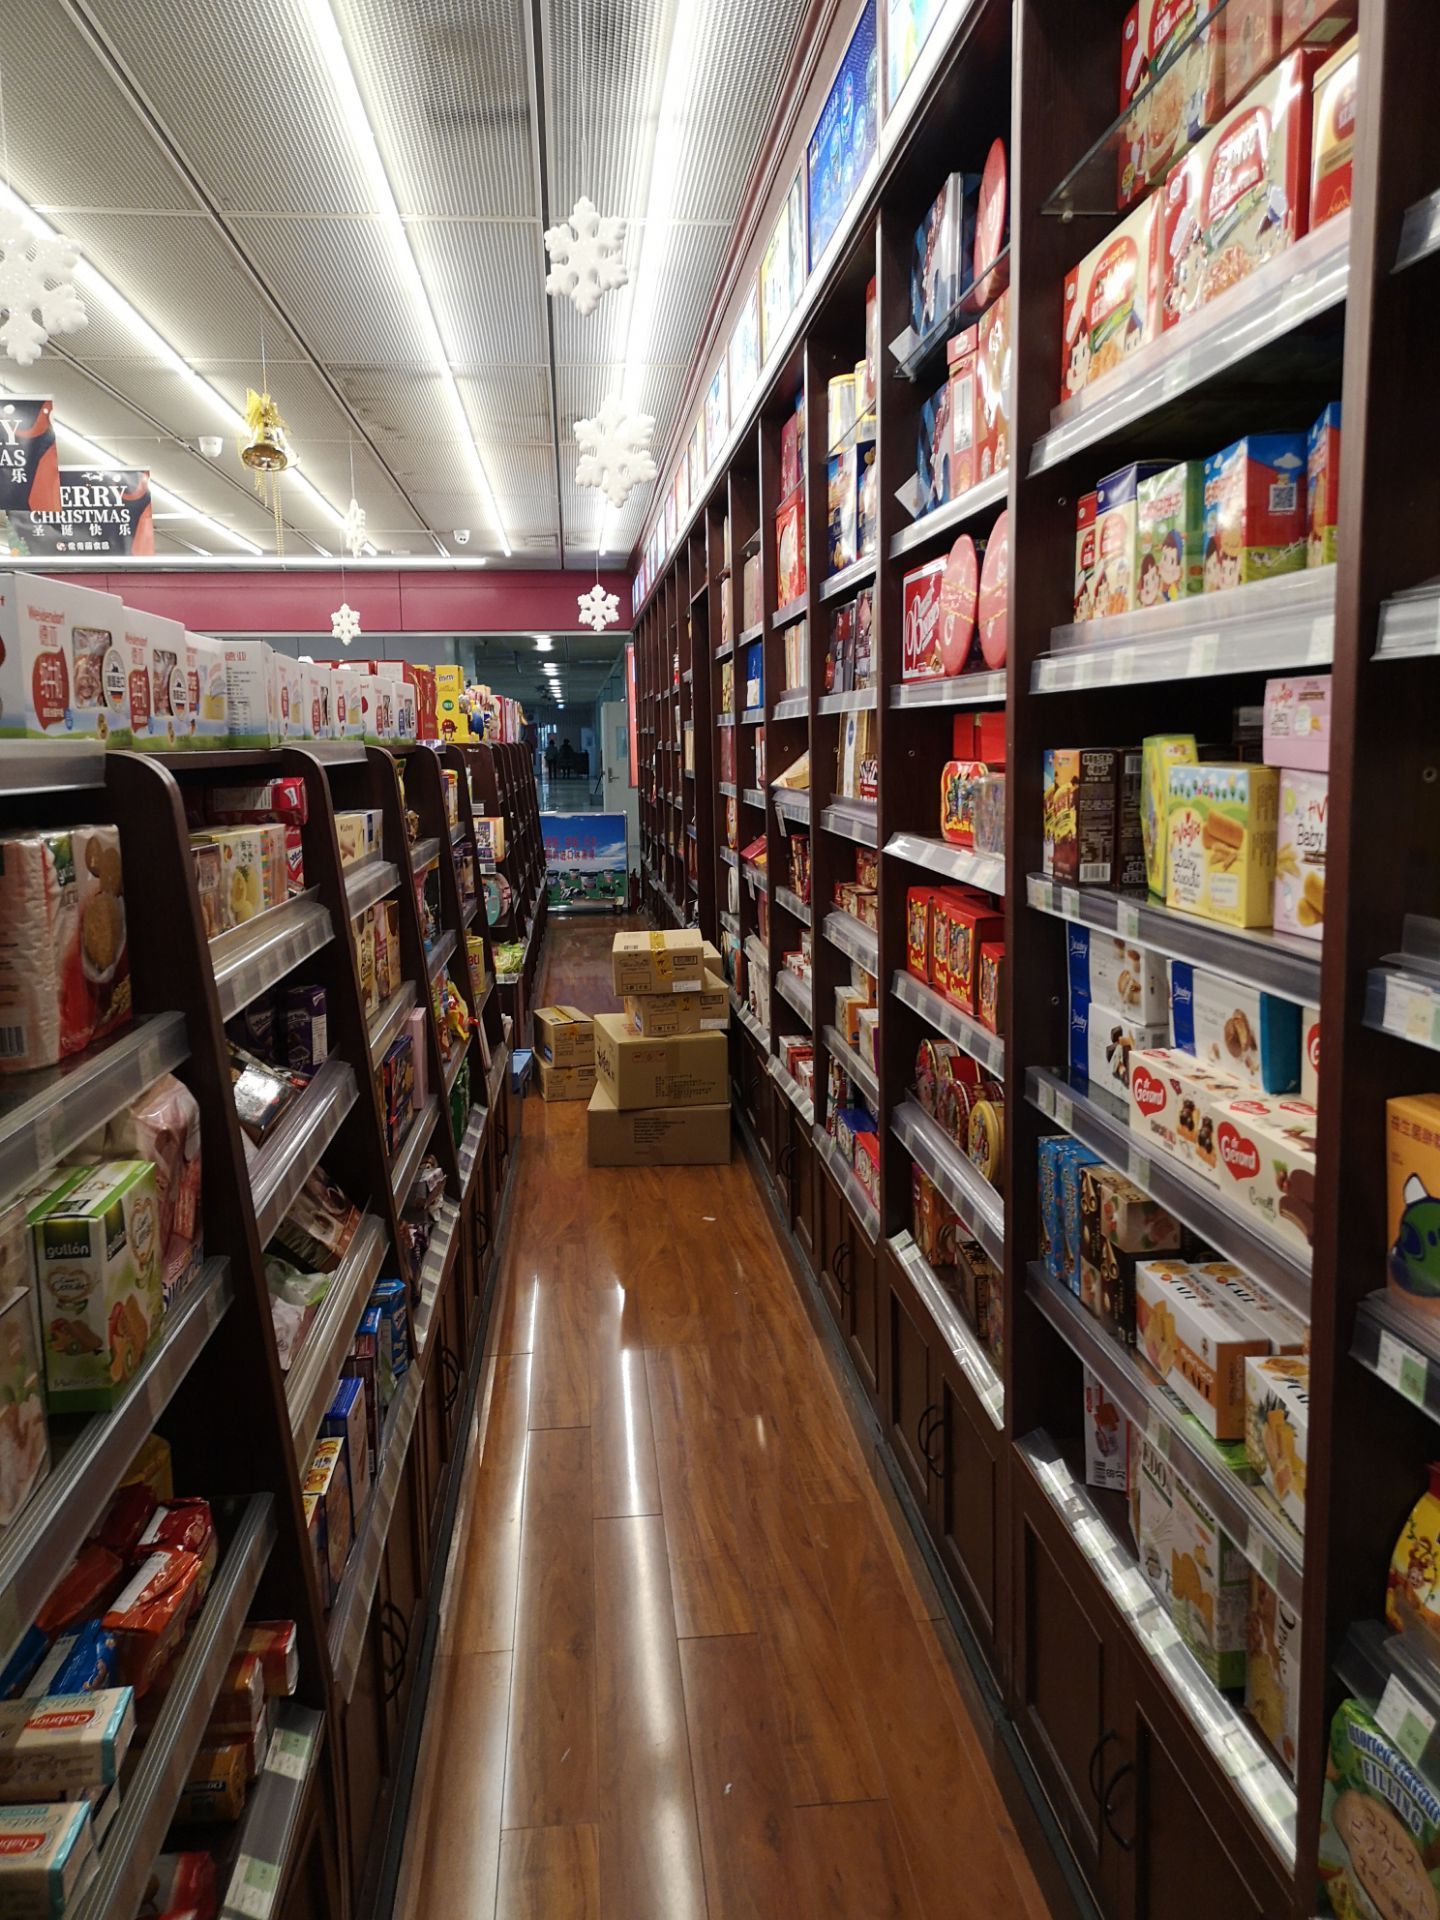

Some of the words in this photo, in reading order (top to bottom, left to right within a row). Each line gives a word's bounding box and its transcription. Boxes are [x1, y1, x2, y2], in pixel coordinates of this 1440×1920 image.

[60, 485, 128, 507] ERRY
[30, 509, 131, 524] CHRISTMAS
[1297, 823, 1324, 854] Baby
[46, 1244, 89, 1259] gullón
[30, 1713, 92, 1727] Chabrior
[1361, 1754, 1424, 1838] FILLING
